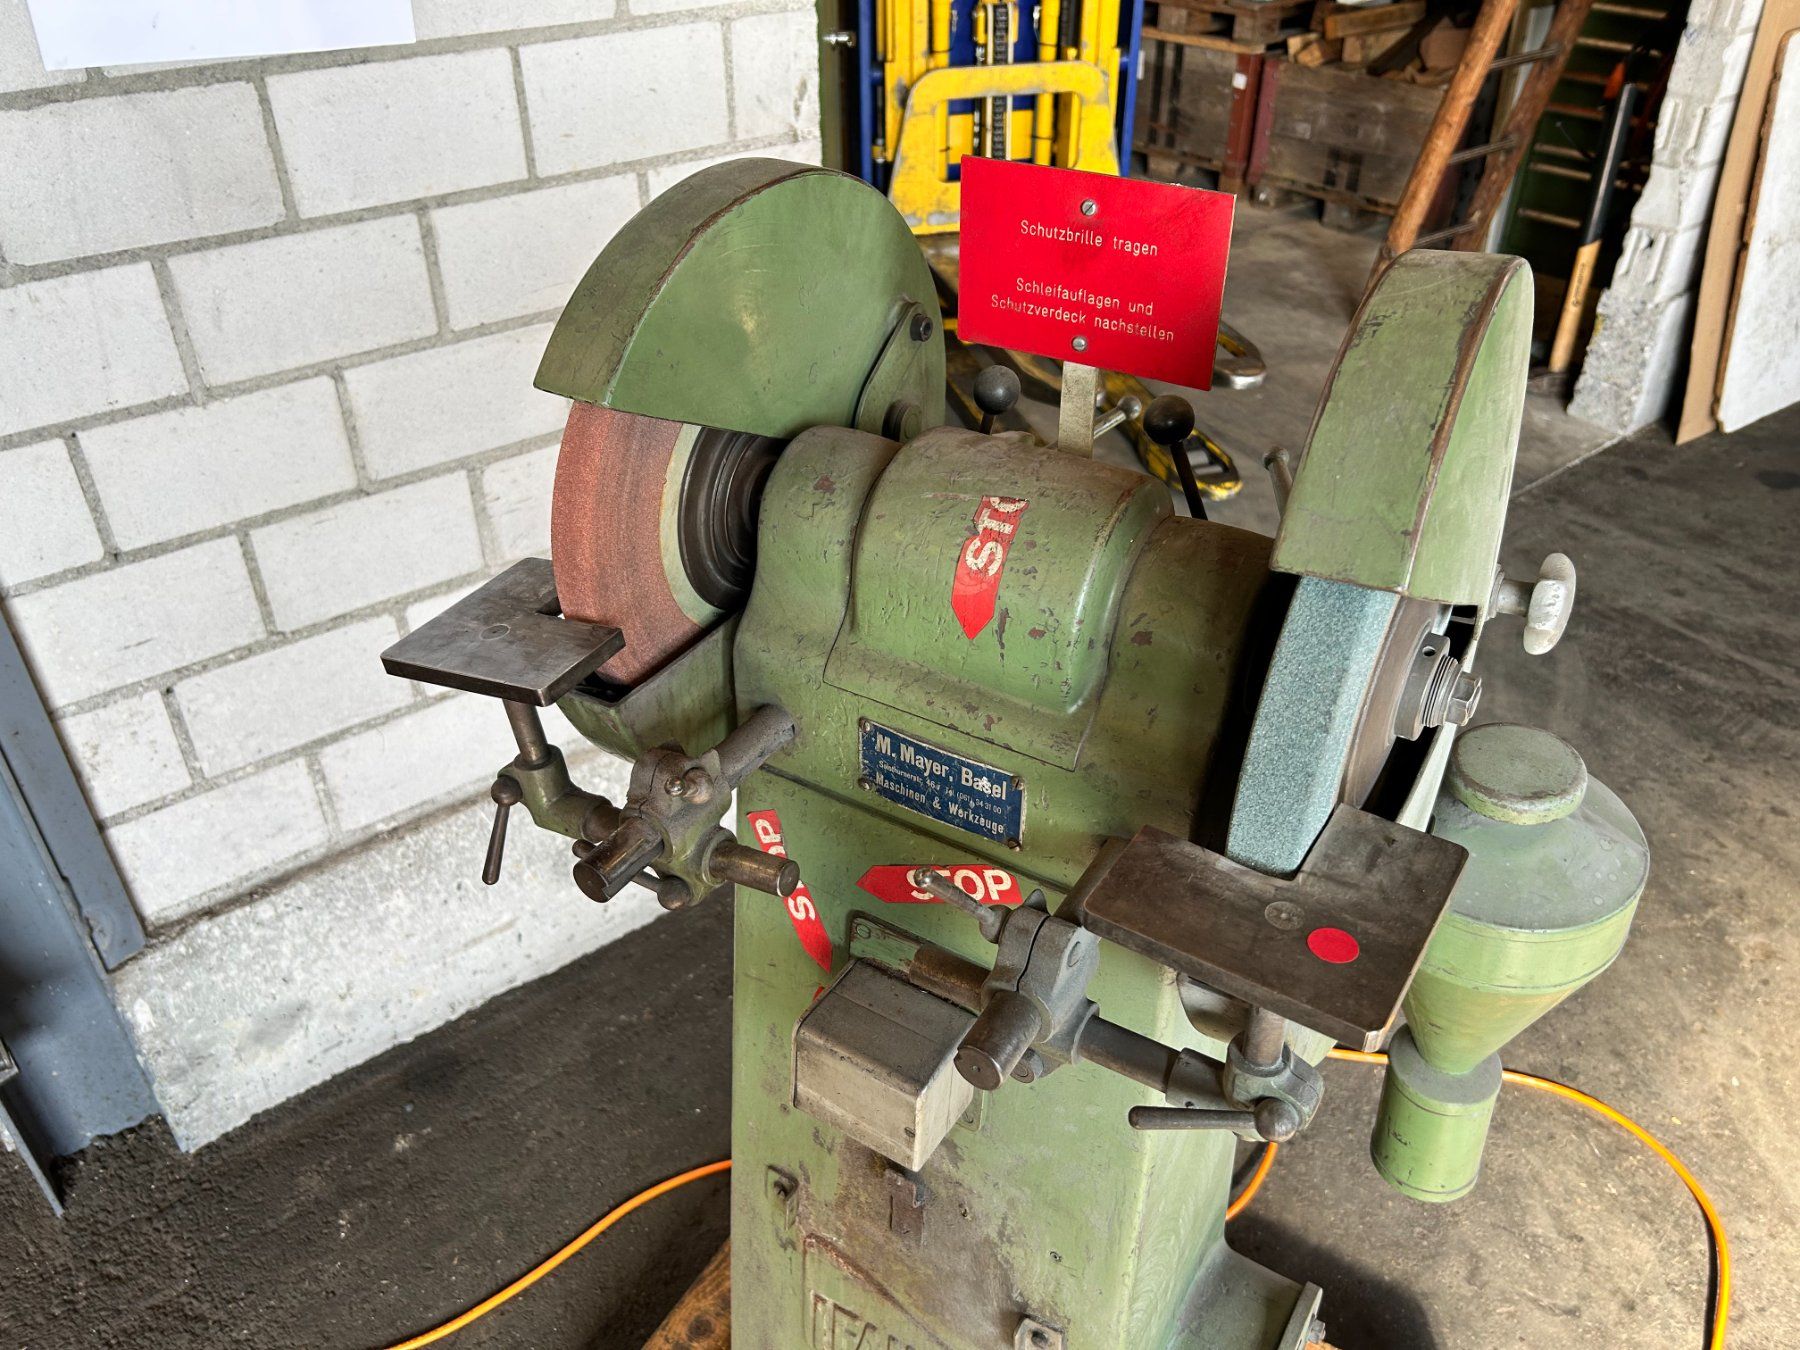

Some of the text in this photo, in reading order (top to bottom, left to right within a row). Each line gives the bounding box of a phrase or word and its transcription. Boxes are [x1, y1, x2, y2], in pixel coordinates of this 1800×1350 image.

[1020, 219, 1159, 257] Schutzbrille tragen
[991, 294, 1175, 343] Schutzverdeck nachstellen
[1015, 277, 1154, 317] Schleifauflagen und
[876, 731, 896, 758] M.
[961, 765, 1007, 801] Basel
[875, 771, 1004, 834] Maschinen & Werkzeuge
